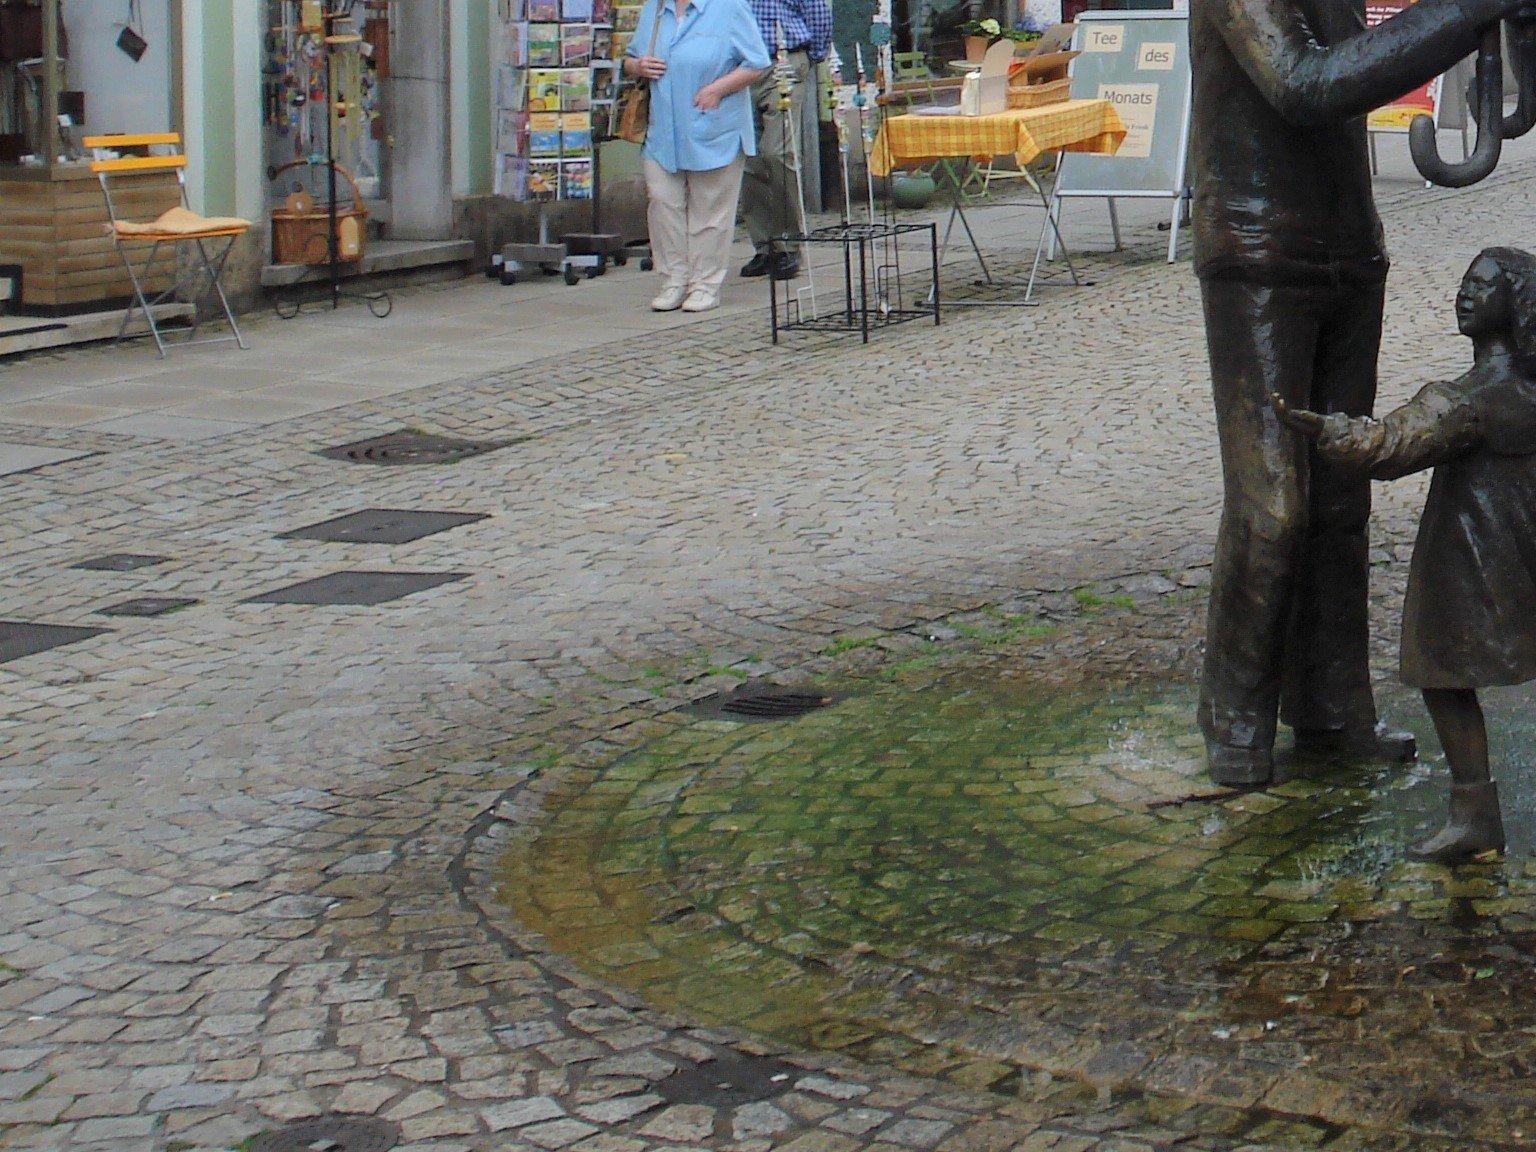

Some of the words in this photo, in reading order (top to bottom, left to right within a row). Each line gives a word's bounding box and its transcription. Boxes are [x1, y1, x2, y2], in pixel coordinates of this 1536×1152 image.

[1093, 32, 1117, 44] Tee
[1145, 49, 1169, 63] des
[1104, 91, 1152, 105] Monats
